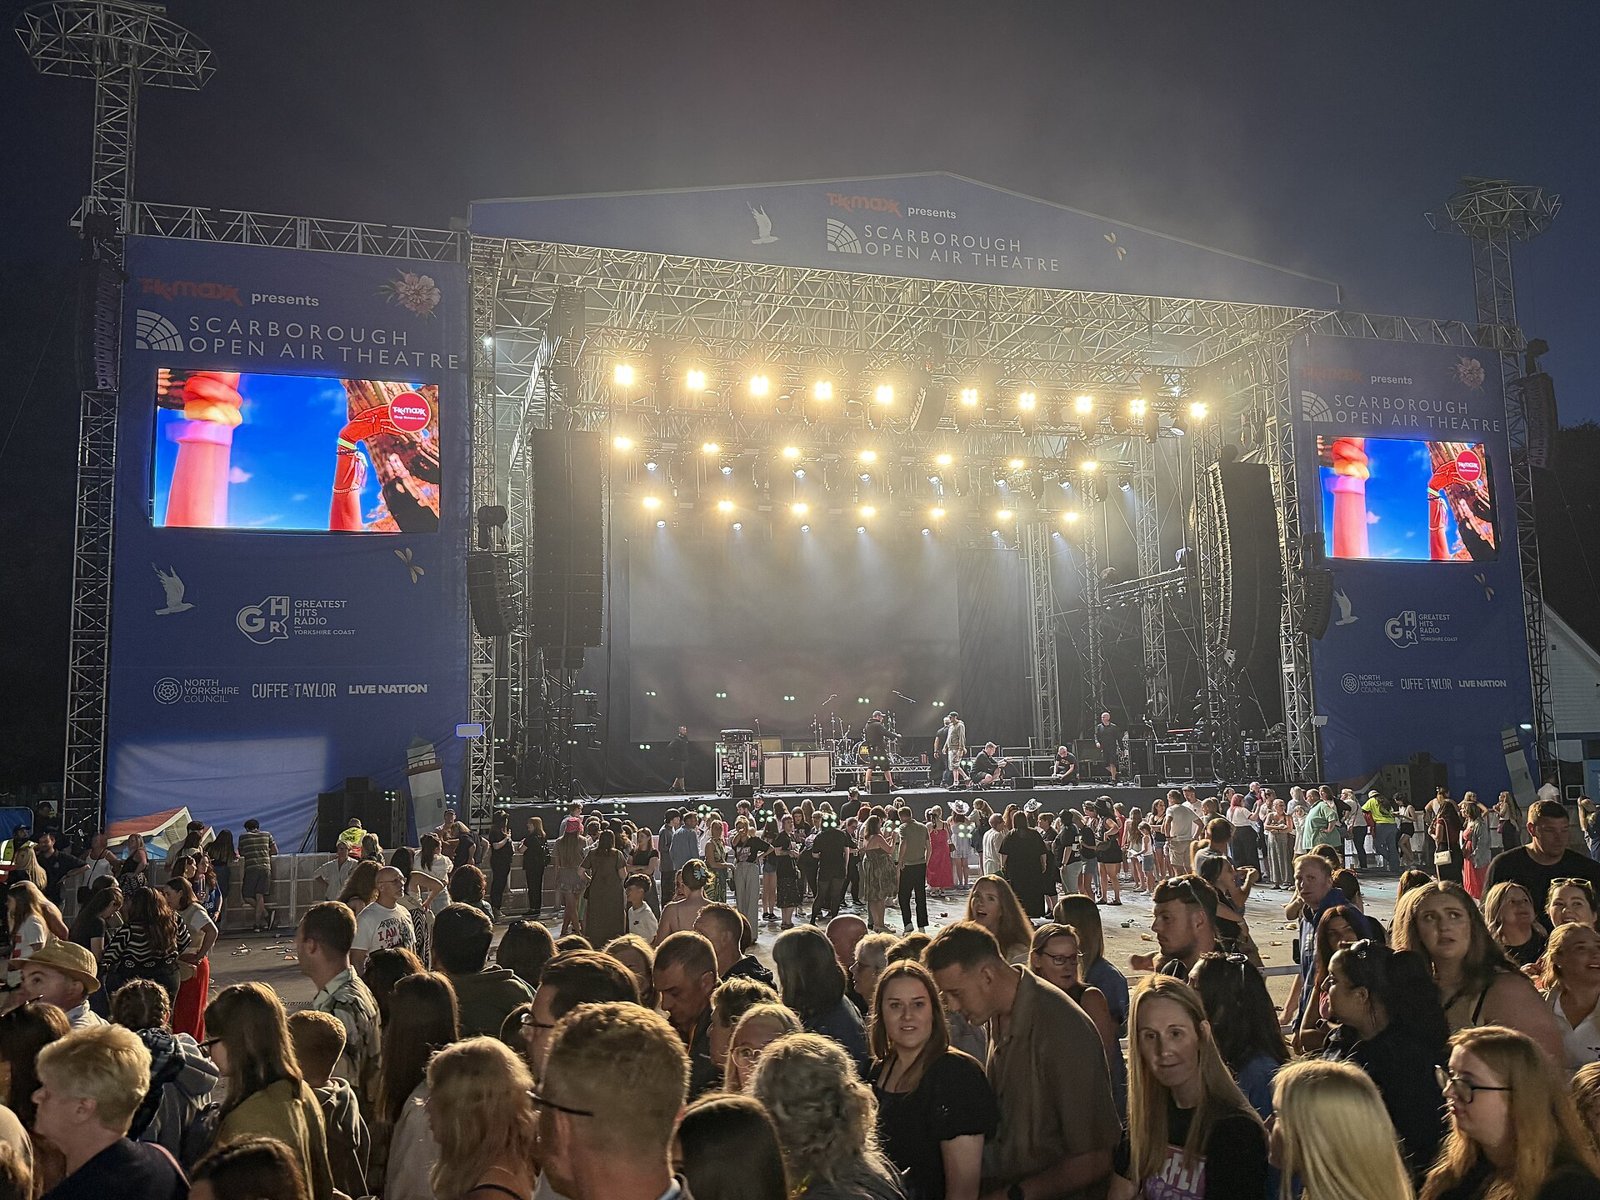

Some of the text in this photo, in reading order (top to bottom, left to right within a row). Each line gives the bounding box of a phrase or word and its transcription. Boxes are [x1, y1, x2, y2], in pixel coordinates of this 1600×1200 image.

[908, 207, 957, 219] presents
[864, 225, 1022, 253] SCARBOROUGH
[865, 242, 1060, 272] OPEN AIR THEATRE
[251, 293, 320, 307] presents
[189, 316, 408, 346] SCARBOROUGH
[189, 337, 459, 369] OPEN AIR THEATRE
[1370, 374, 1413, 385] presents
[1335, 394, 1469, 415] SCARBOROUGH
[1336, 410, 1500, 432] OPEN AIR THEATRE
[294, 600, 348, 609] GREATEST
[294, 608, 318, 617] HITS
[1418, 613, 1450, 621] GREATEST
[294, 617, 327, 626] RADIO
[184, 679, 219, 687] NORTH
[1400, 678, 1453, 690] CUFFE TAYLOR
[1458, 680, 1507, 688] LIVE NATION
[184, 686, 240, 695] YORKSHIRE
[252, 683, 289, 698] CUFFE
[294, 682, 337, 698] TAYLOR
[348, 684, 428, 695] LIVE NATION
[183, 695, 229, 703] COUNCIL
